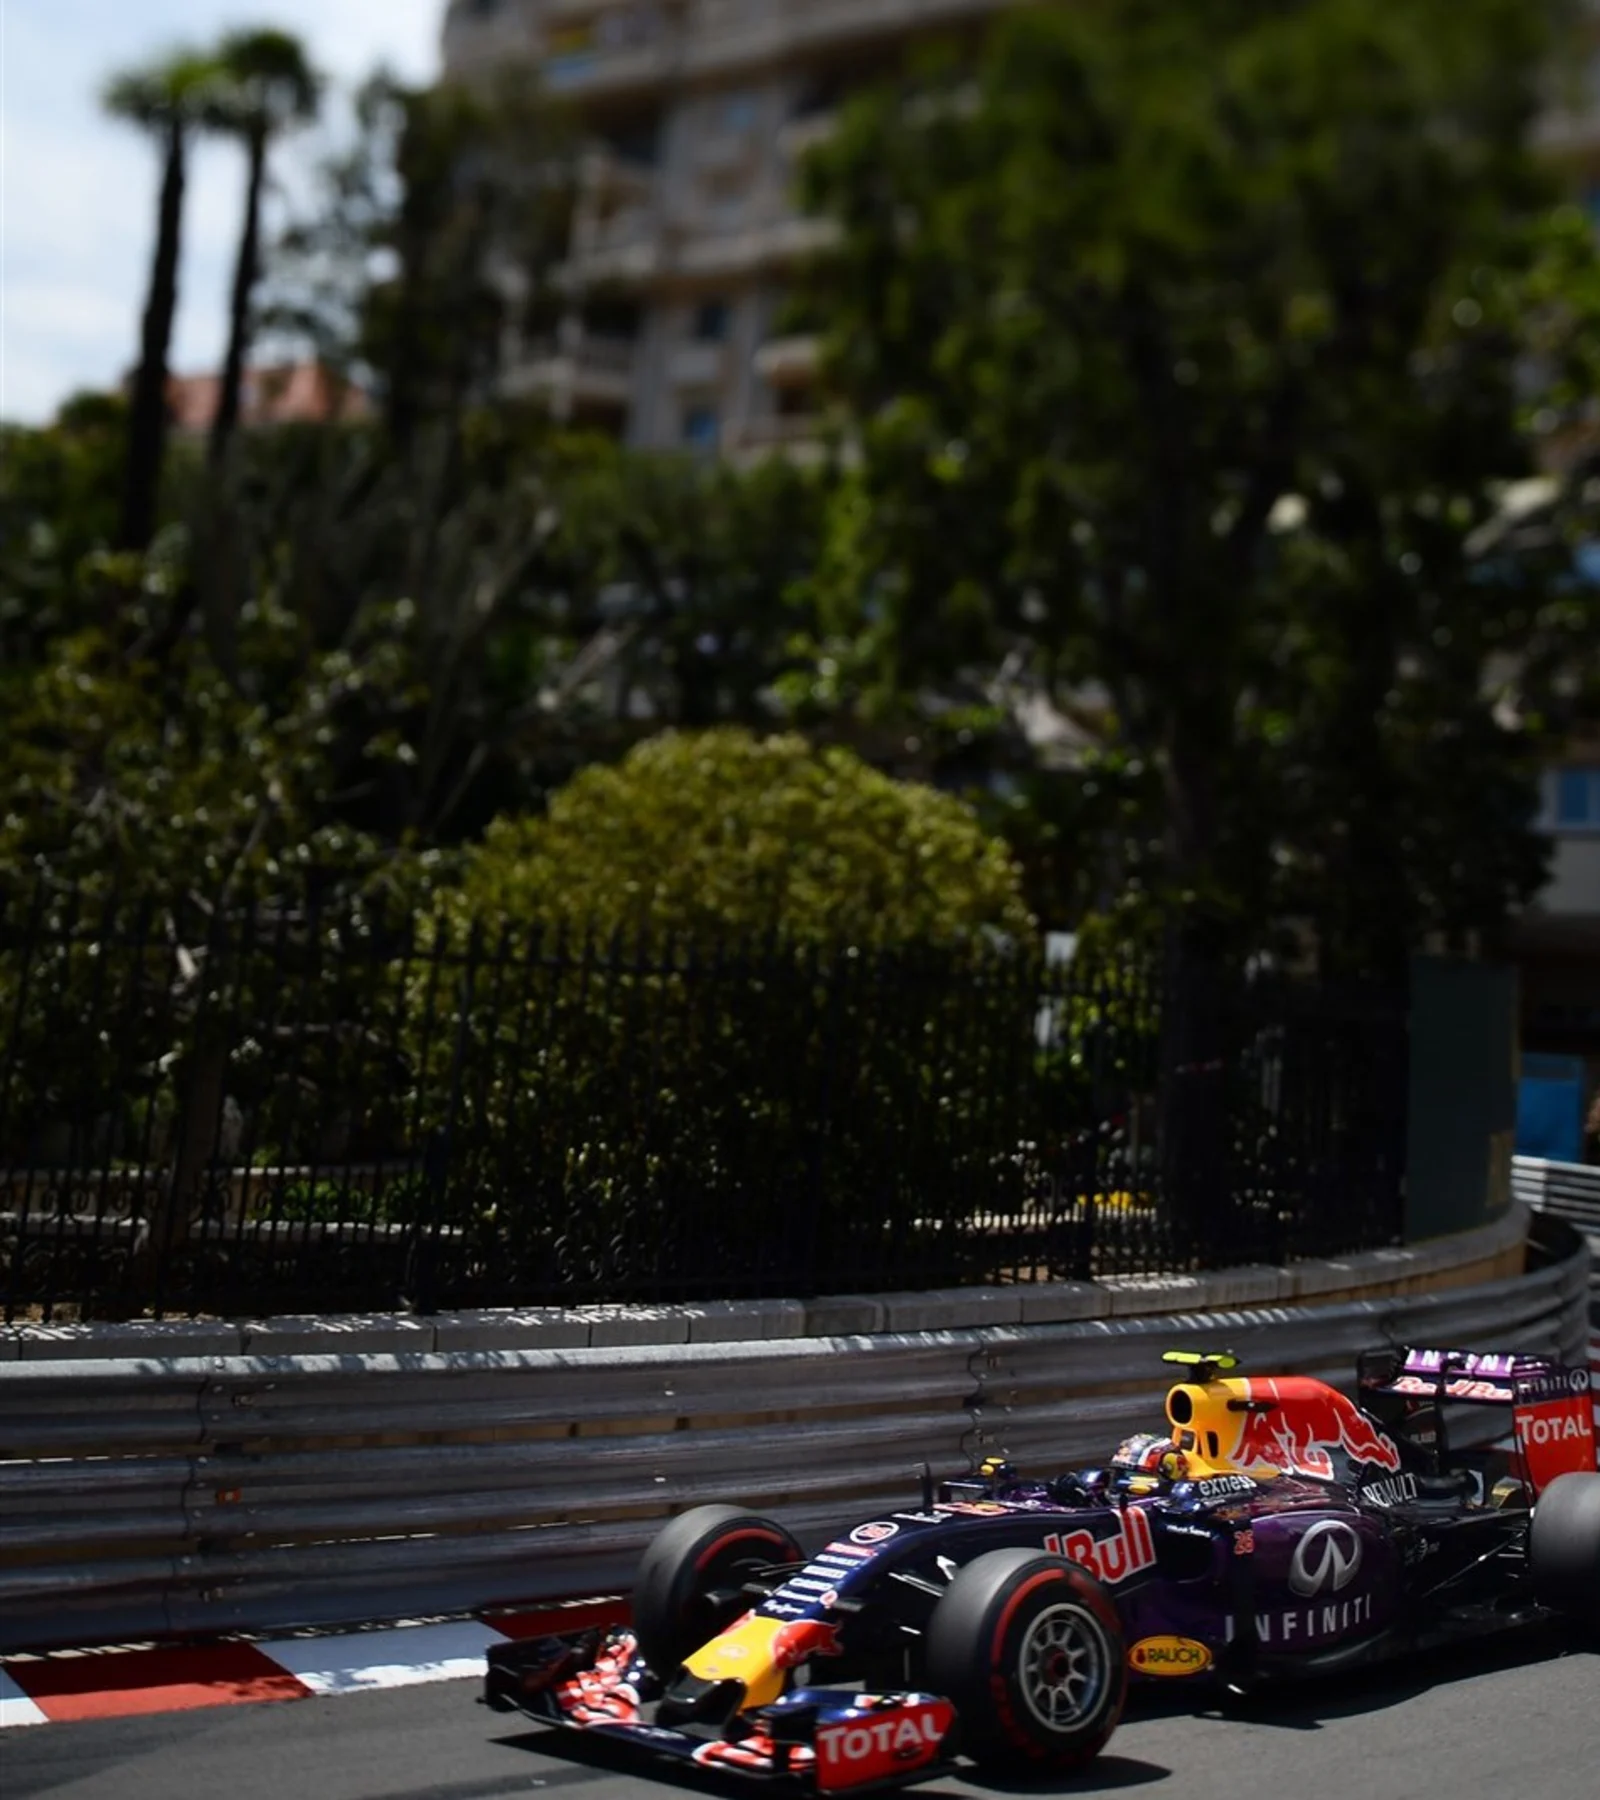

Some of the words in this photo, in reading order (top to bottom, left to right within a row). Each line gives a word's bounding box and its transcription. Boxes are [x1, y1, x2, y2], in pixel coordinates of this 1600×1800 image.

[1516, 1414, 1592, 1445] TOTAL
[1200, 1475, 1257, 1497] exness
[1062, 1505, 1157, 1584] Bull
[1147, 1647, 1201, 1663] RAUCH
[817, 1713, 944, 1764] TOTAL
